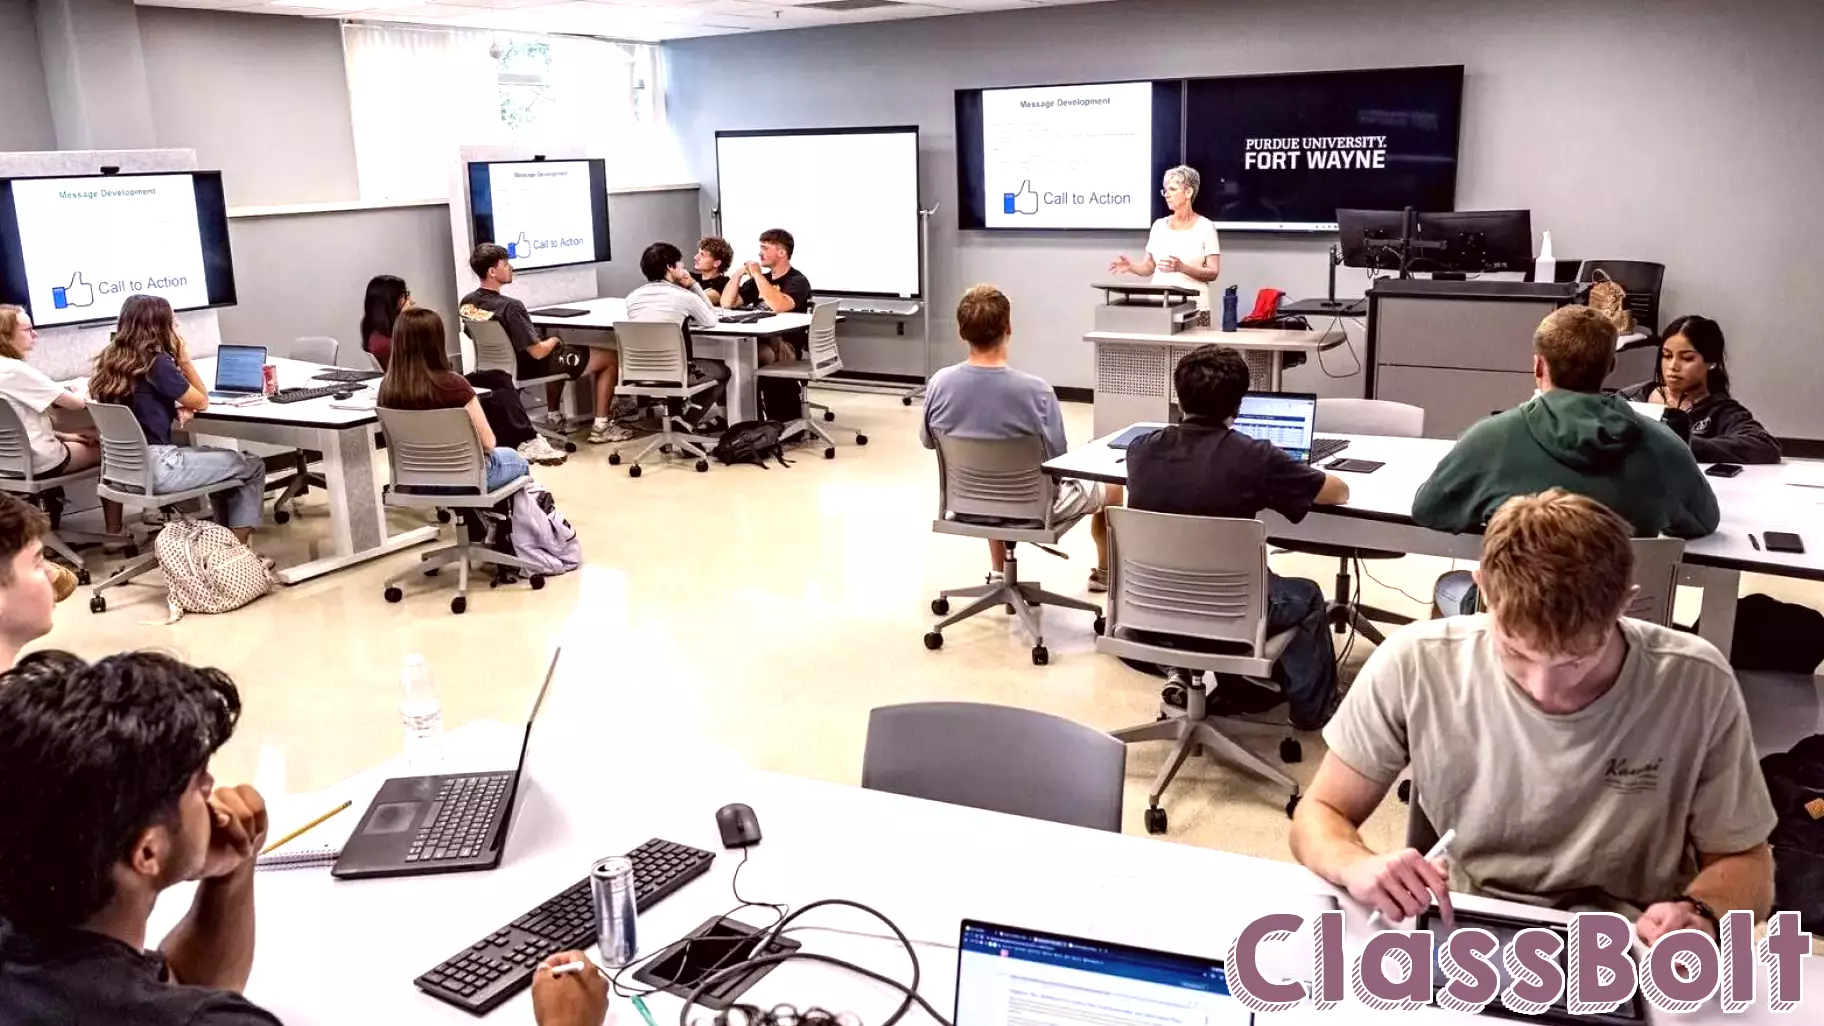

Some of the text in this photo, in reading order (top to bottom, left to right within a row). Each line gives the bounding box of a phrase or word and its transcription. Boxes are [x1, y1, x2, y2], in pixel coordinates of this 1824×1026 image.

[1020, 97, 1111, 108] Message Development
[1246, 138, 1300, 150] PURDUE
[1245, 150, 1385, 170] FORT WAYNE
[59, 187, 156, 199] Message Development
[1043, 191, 1131, 205] Call to Action
[533, 237, 584, 249] Call to Action
[98, 274, 188, 295] Call to Action
